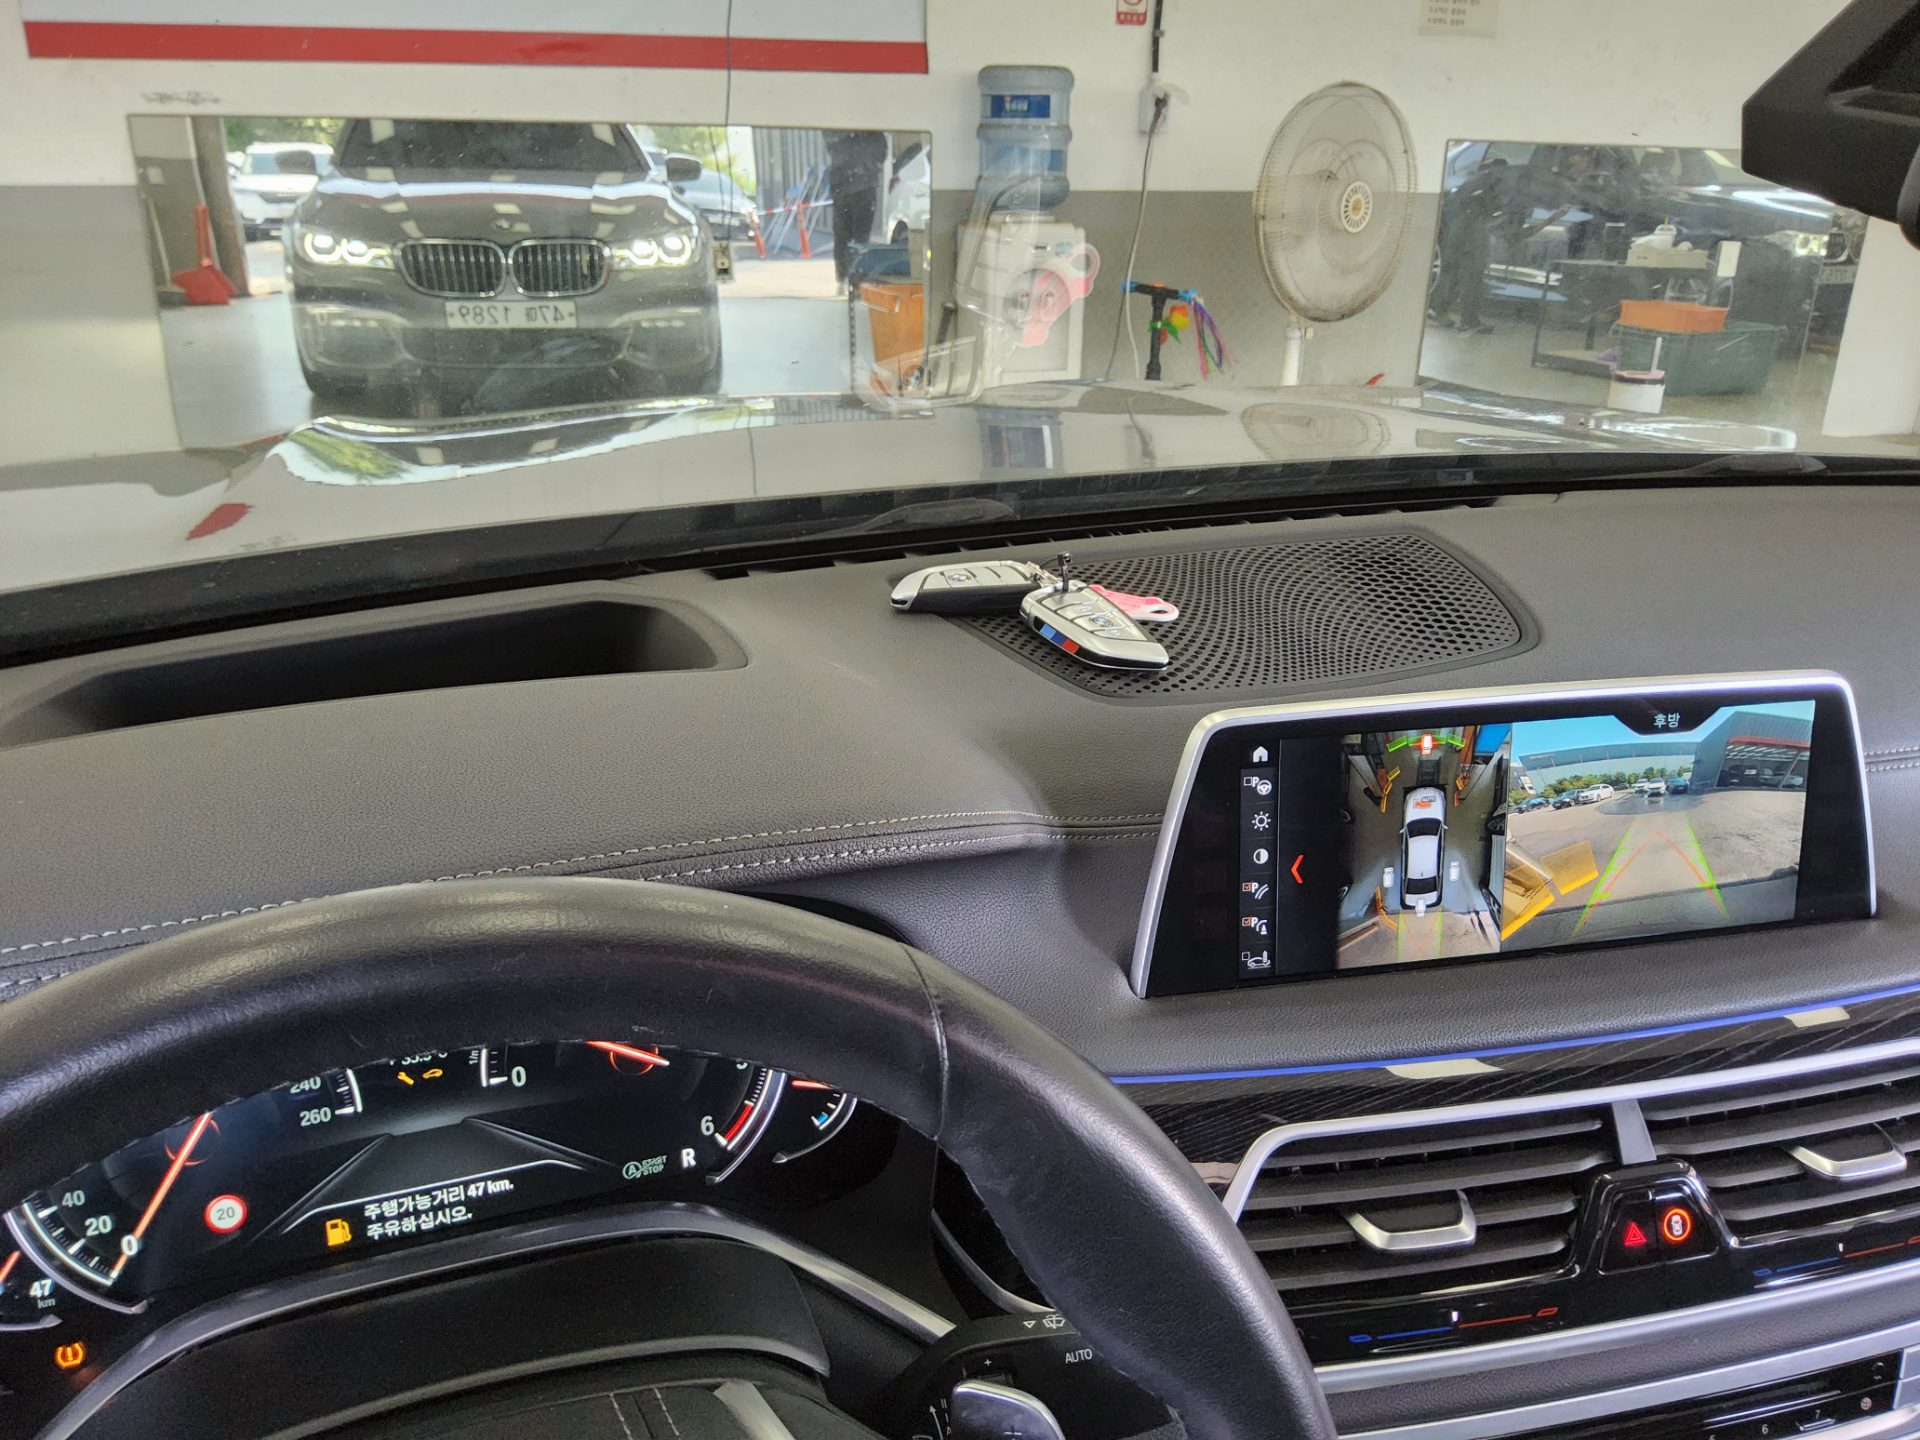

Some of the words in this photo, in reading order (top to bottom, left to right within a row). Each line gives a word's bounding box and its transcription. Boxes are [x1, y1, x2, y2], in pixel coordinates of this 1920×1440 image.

[1653, 712, 1681, 729] 후방
[511, 1065, 527, 1087] 0
[299, 1106, 332, 1127] 260
[700, 1115, 715, 1136] 6
[681, 1147, 697, 1169] R
[642, 1164, 664, 1176] STOP
[61, 1189, 86, 1208] 40
[364, 1184, 465, 1220] 주행가능거리
[467, 1181, 486, 1198] 47
[216, 1206, 236, 1221] 20
[367, 1206, 473, 1240] 주유하십시오.
[84, 1214, 112, 1237] 20
[121, 1234, 139, 1256] 0
[29, 1278, 52, 1298] 47
[37, 1298, 56, 1309] km
[1065, 1348, 1093, 1365] AUTO
[1761, 1423, 1769, 1436] 6
